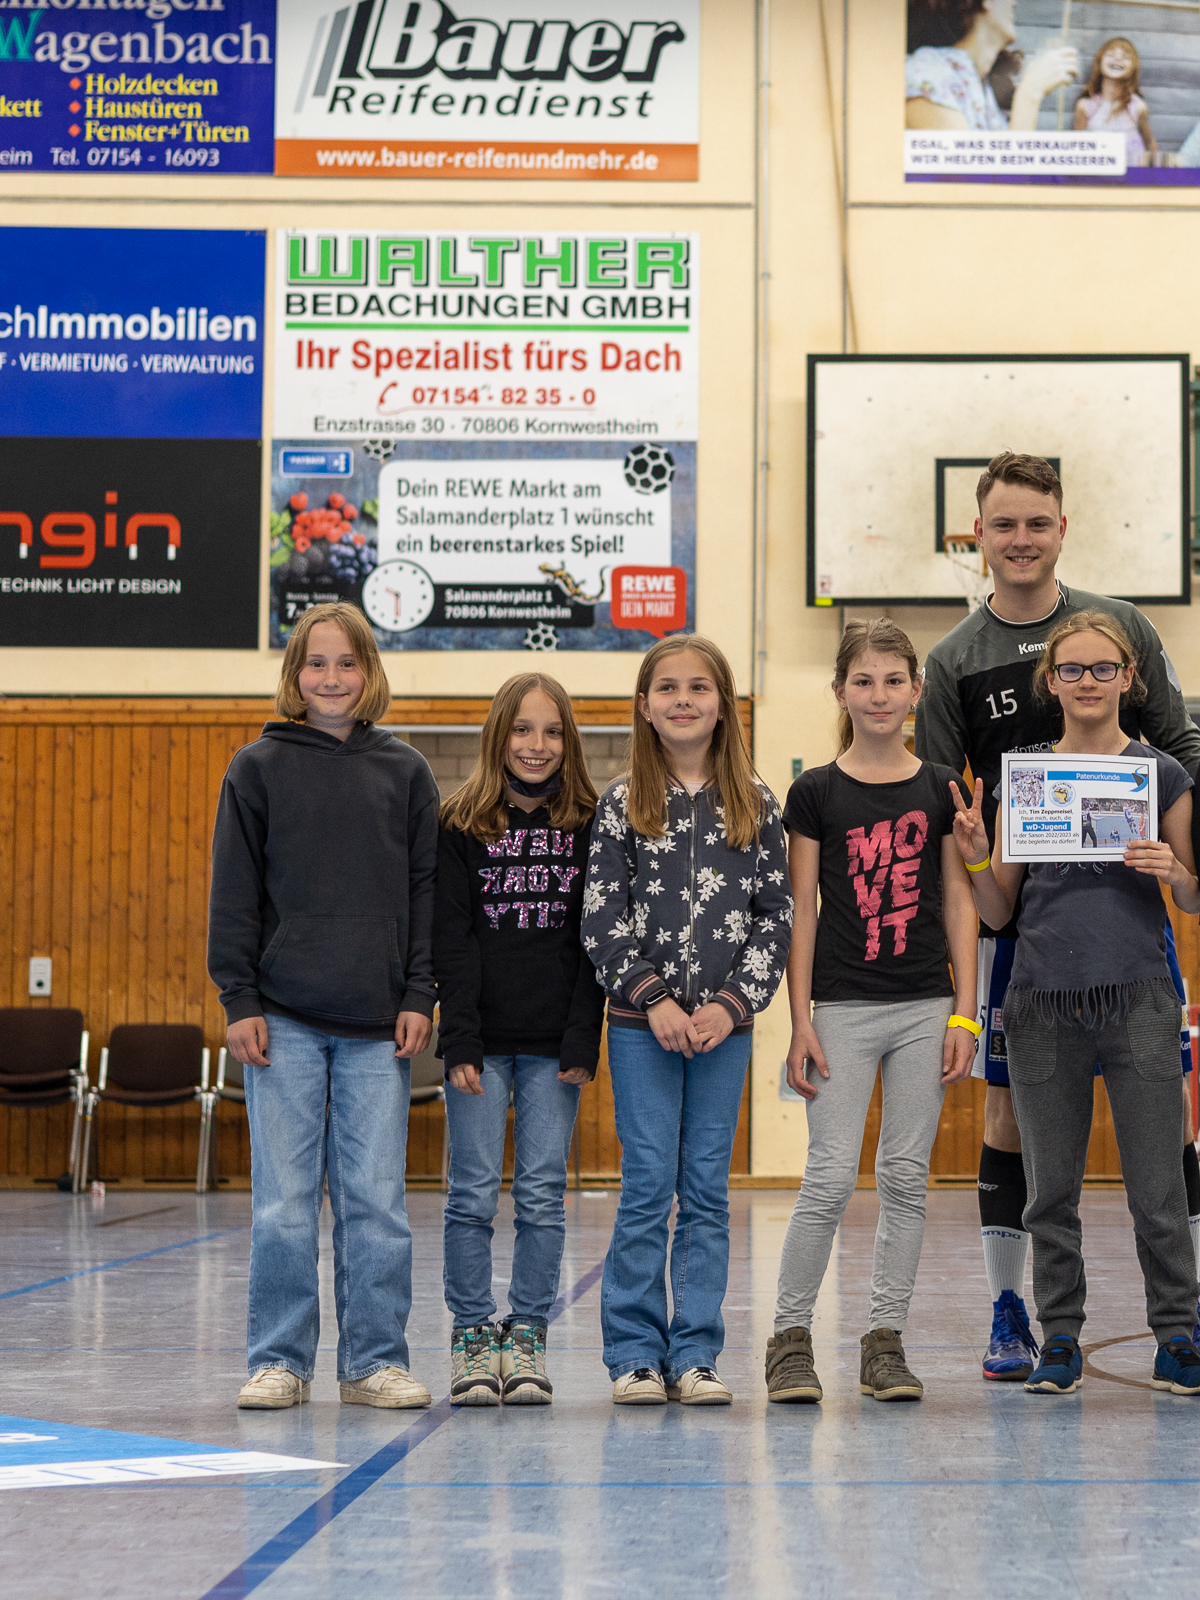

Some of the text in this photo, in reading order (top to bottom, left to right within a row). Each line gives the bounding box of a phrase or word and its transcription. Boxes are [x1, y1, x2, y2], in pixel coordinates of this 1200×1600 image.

[0, 8, 272, 73] Wagenbach
[338, 0, 686, 82] Bauer
[85, 74, 218, 95] Holzdecken
[85, 98, 202, 118] Haustüren
[327, 84, 654, 118] Reifendienst
[84, 121, 250, 142] Fenster+Türen
[911, 139, 1098, 152] EGAL, WAS SIE VERKAUFEN
[51, 148, 79, 166] Tel.
[87, 148, 141, 166] 07154
[165, 148, 220, 167] 16093
[316, 146, 659, 172] www.bauer-reifenundmehr.de
[911, 154, 1117, 167] WIR HELFEN BEIM KASSIEREN
[286, 235, 690, 289] WALTHER
[285, 293, 690, 319] BEDACHUNGEN GMBH
[0, 304, 257, 342] chImmobilien
[19, 352, 255, 375] VERMIETUNG VERWALTUNG
[296, 339, 681, 378] Ihr Spezialist fürs Dach
[412, 386, 597, 406] 07154 82 35 0
[313, 416, 659, 435] Enzstrasse 30 70806 Kornwestheim
[397, 478, 601, 498] Dein REWE Markt am
[396, 506, 655, 531] Salamanderplatz 1 wünscht
[396, 534, 625, 557] ein beerenstarkes Spiel!
[0, 578, 181, 594] ECHNIK LICHT DESIGN
[621, 575, 676, 592] REWE
[444, 588, 543, 604] Salamanderplatz
[444, 606, 572, 619] 70806 Kornwestheim
[985, 688, 1018, 720] 15
[1076, 772, 1121, 781] Patenurkunde
[1025, 823, 1068, 831] wD-Jugend
[845, 810, 929, 876] MO
[853, 858, 921, 919] VE
[864, 905, 919, 961] IT
